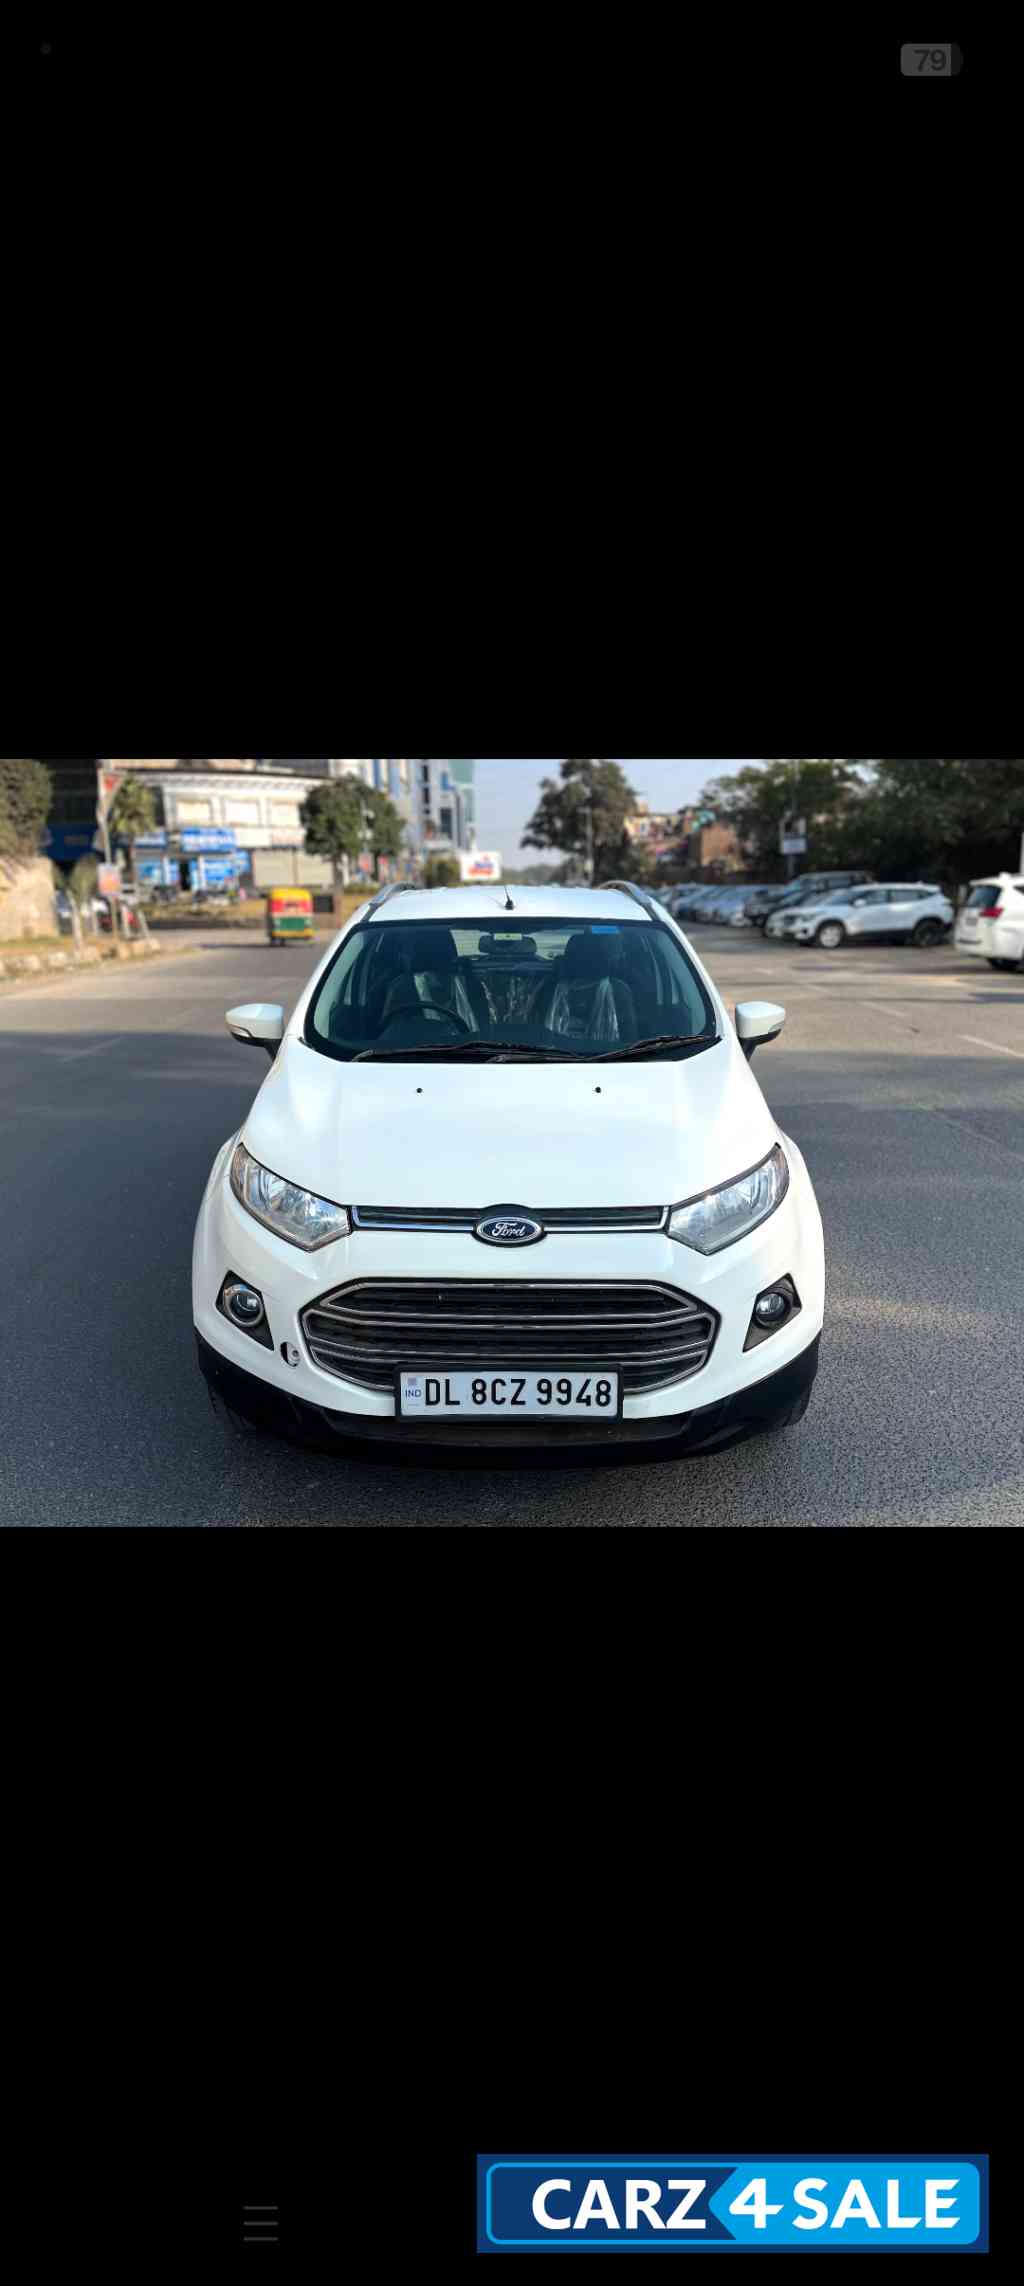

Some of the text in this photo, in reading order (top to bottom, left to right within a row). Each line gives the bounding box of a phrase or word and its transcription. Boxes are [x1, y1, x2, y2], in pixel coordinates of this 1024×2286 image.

[491, 1222, 526, 1237] Ford
[405, 1389, 421, 1398] IND
[425, 1378, 612, 1407] DL 8CZ 9948
